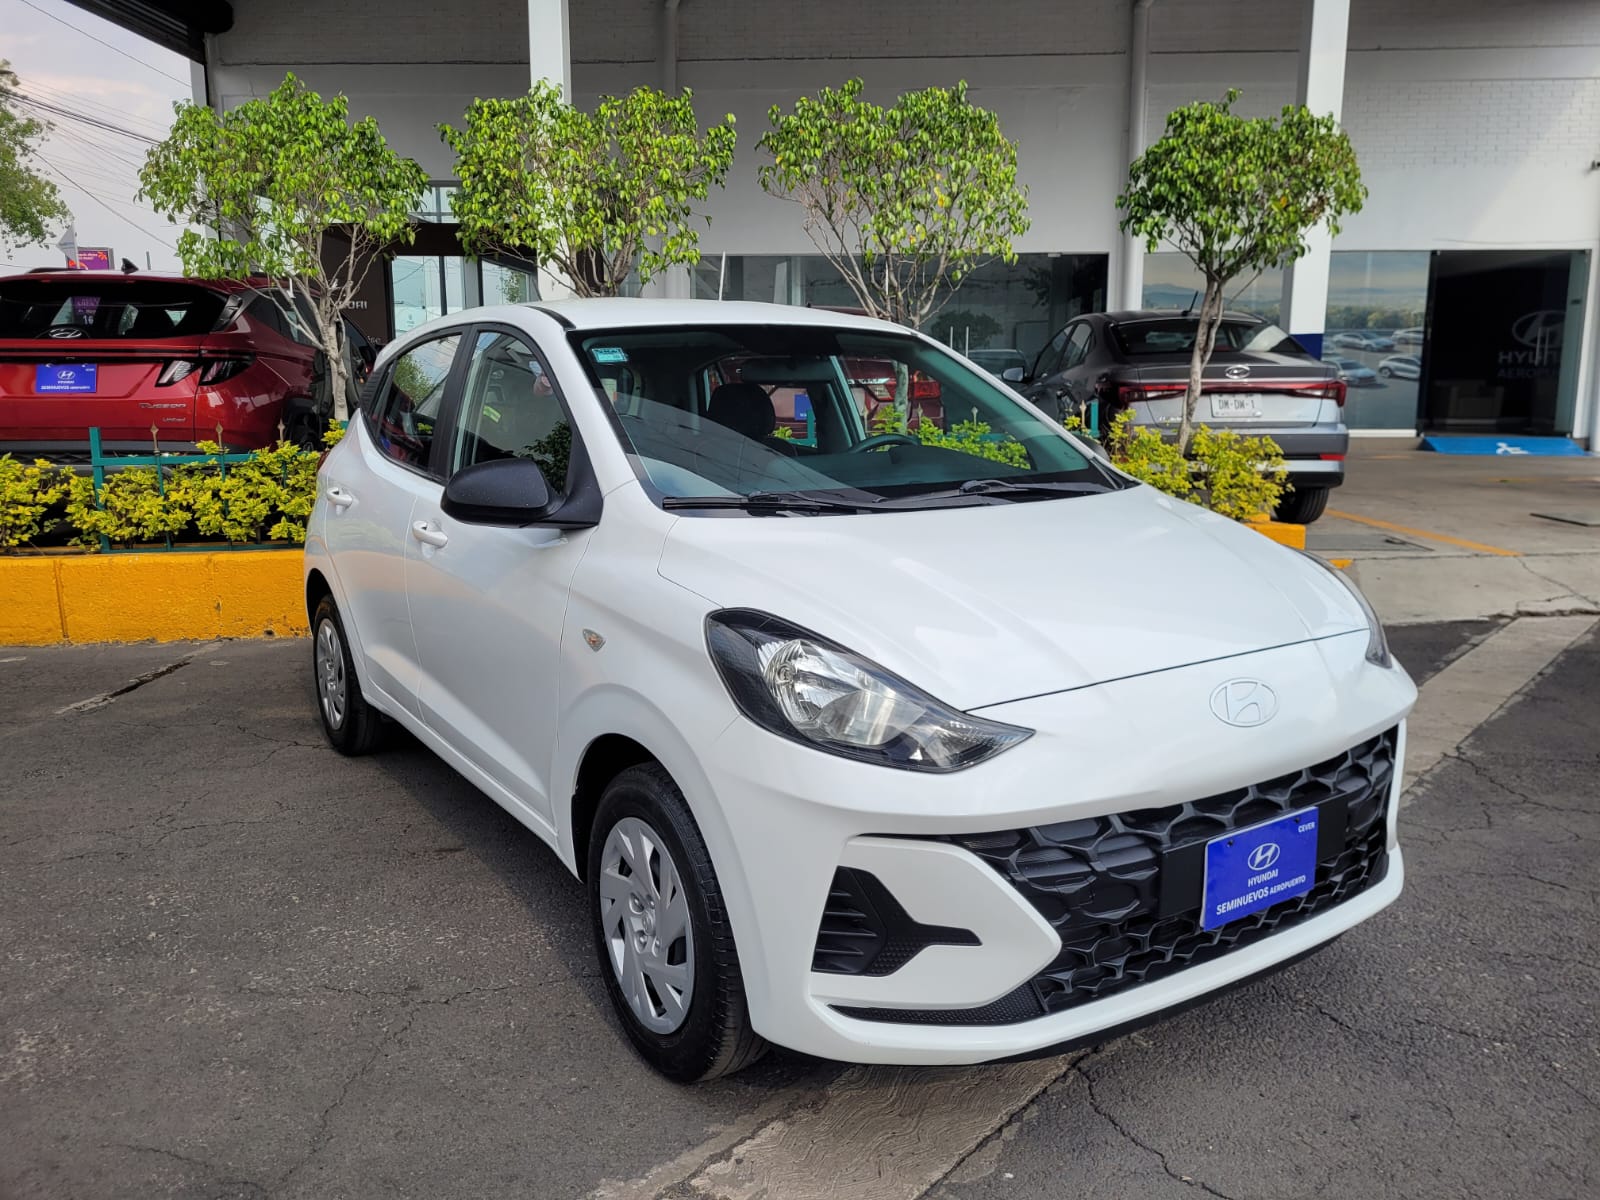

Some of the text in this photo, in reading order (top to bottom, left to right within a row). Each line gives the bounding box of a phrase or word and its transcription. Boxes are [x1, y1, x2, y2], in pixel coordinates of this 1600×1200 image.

[1247, 868, 1279, 888] HYUNDAI
[1215, 874, 1307, 916] SEMINUEVOS AEROPUERTO
